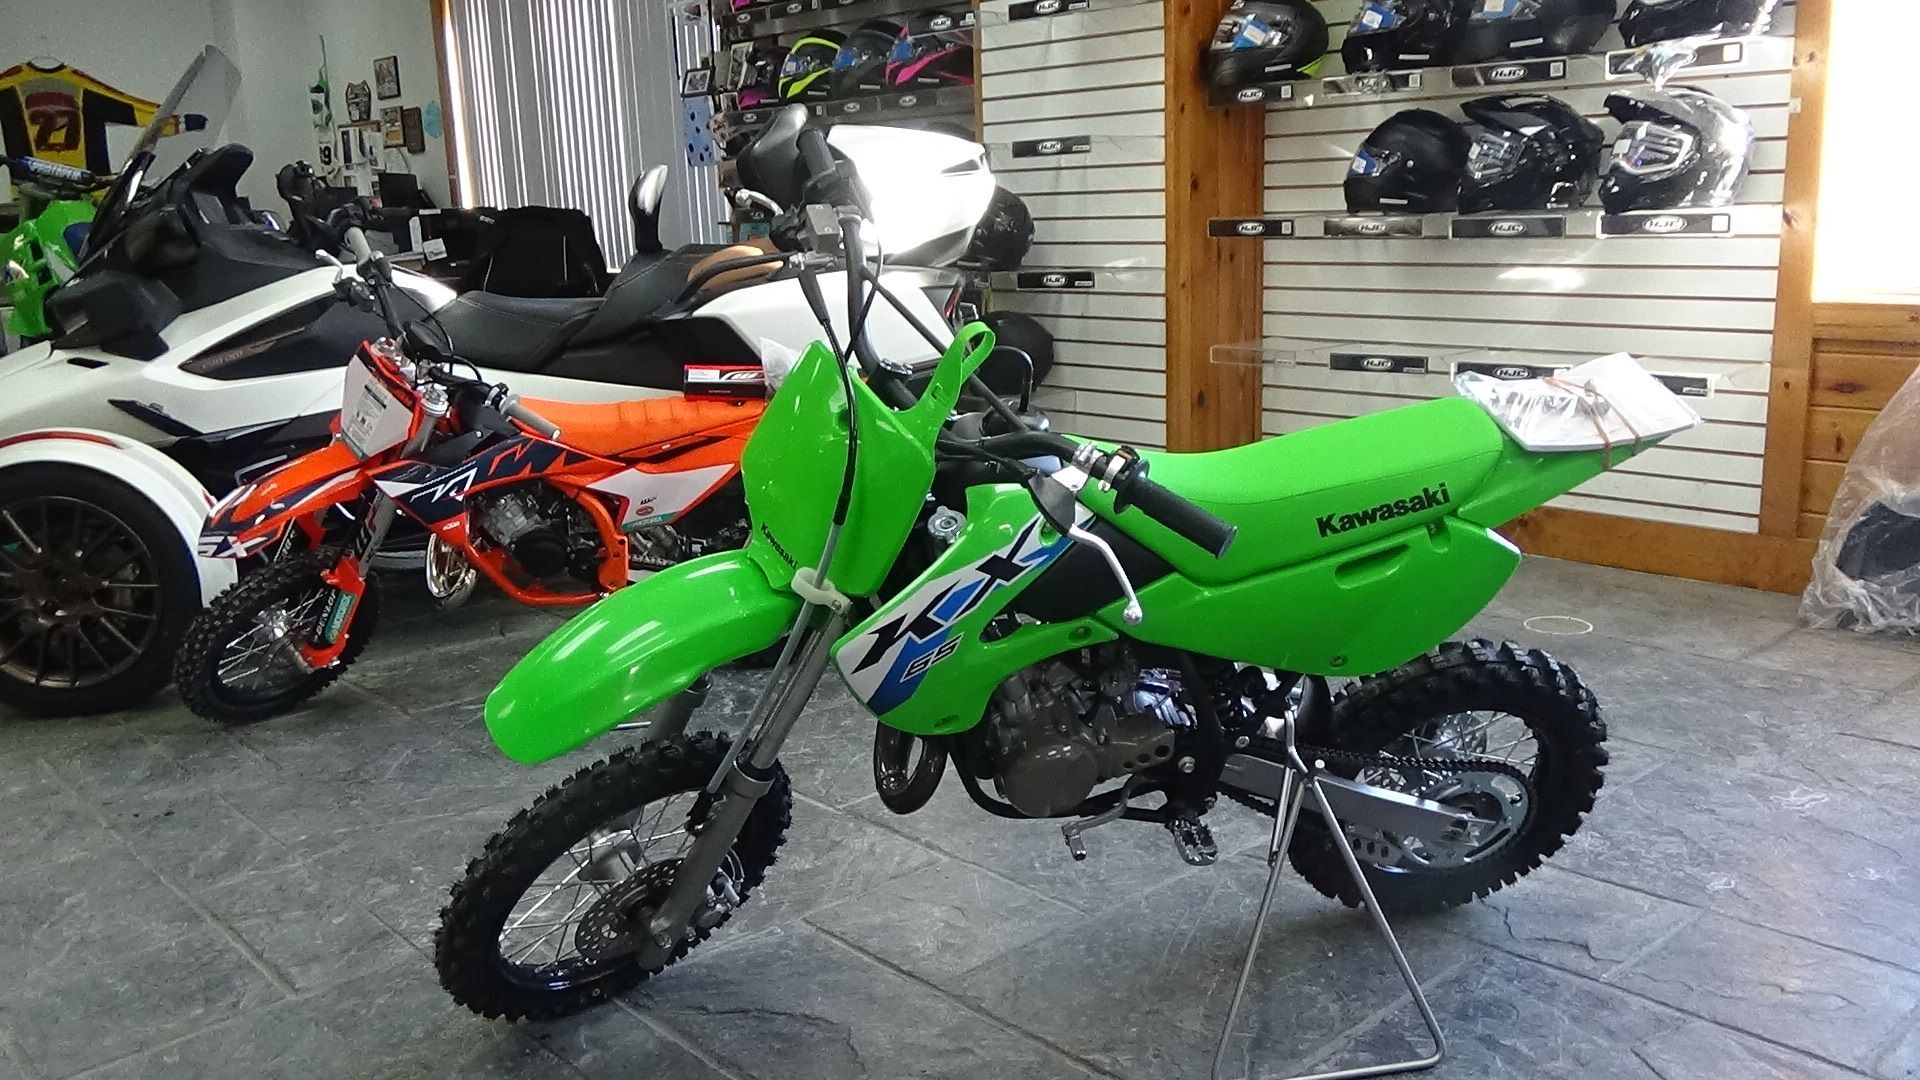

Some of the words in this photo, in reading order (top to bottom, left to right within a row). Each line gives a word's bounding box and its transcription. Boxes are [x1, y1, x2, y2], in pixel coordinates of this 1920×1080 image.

[1494, 68, 1524, 78] HJC
[1239, 89, 1263, 99] HJC
[1240, 223, 1263, 232] HJC
[1360, 223, 1384, 232] HJC
[1493, 224, 1521, 233] HJC
[1366, 359, 1390, 368] HJC
[1499, 369, 1526, 378] HJC
[1316, 482, 1450, 538] Kawasaki
[761, 522, 798, 570] Kawasaki
